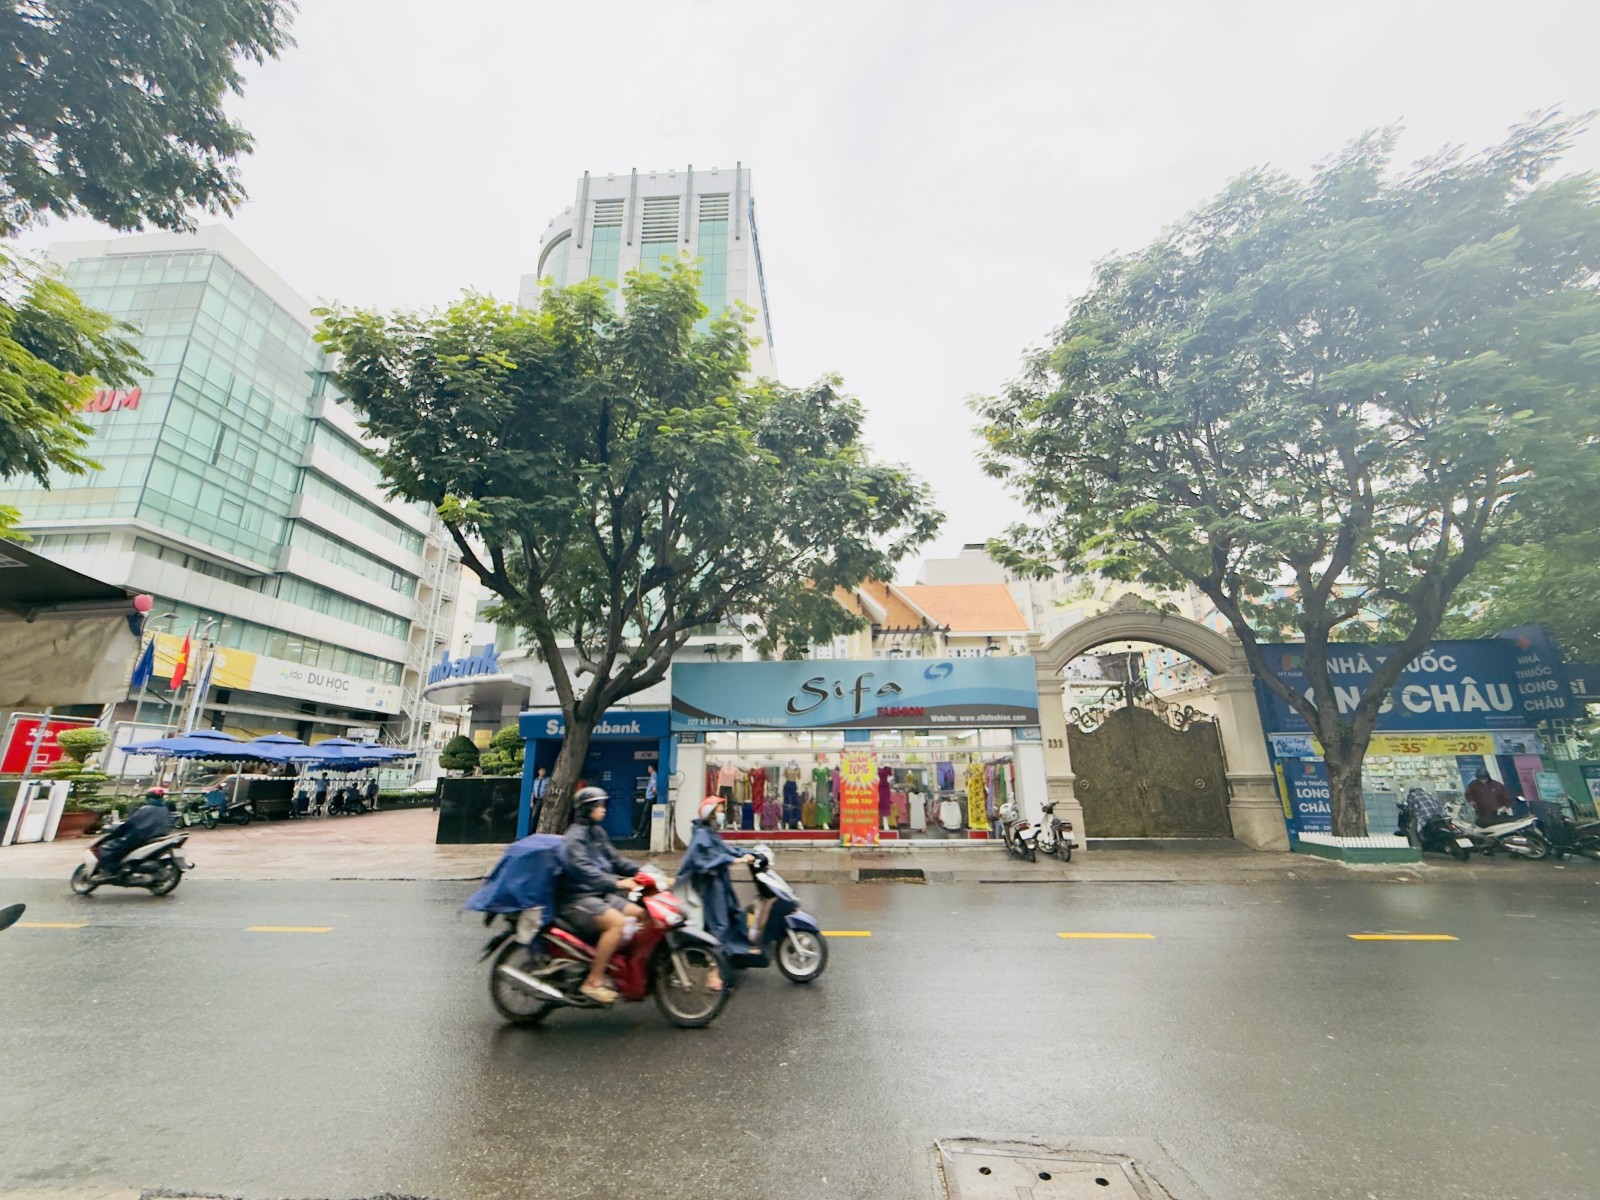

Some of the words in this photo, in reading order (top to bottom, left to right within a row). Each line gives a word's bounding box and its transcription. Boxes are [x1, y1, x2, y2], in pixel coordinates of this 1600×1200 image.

[72, 387, 142, 412] RUM
[1326, 652, 1373, 674] NHÀ
[1376, 649, 1458, 674] UỐC
[1518, 653, 1541, 665] NHÀ
[1515, 666, 1552, 679] THUỐC
[289, 669, 303, 681] idp
[307, 672, 325, 686] DU
[326, 678, 350, 693] HỌC
[1518, 680, 1558, 695] LONG
[784, 672, 903, 718] Sifa
[1402, 676, 1513, 713] CHÂU
[1523, 695, 1565, 711] CHÂU
[876, 706, 926, 717] FASHION
[546, 719, 641, 735] Sambank
[1296, 788, 1330, 798] LONG
